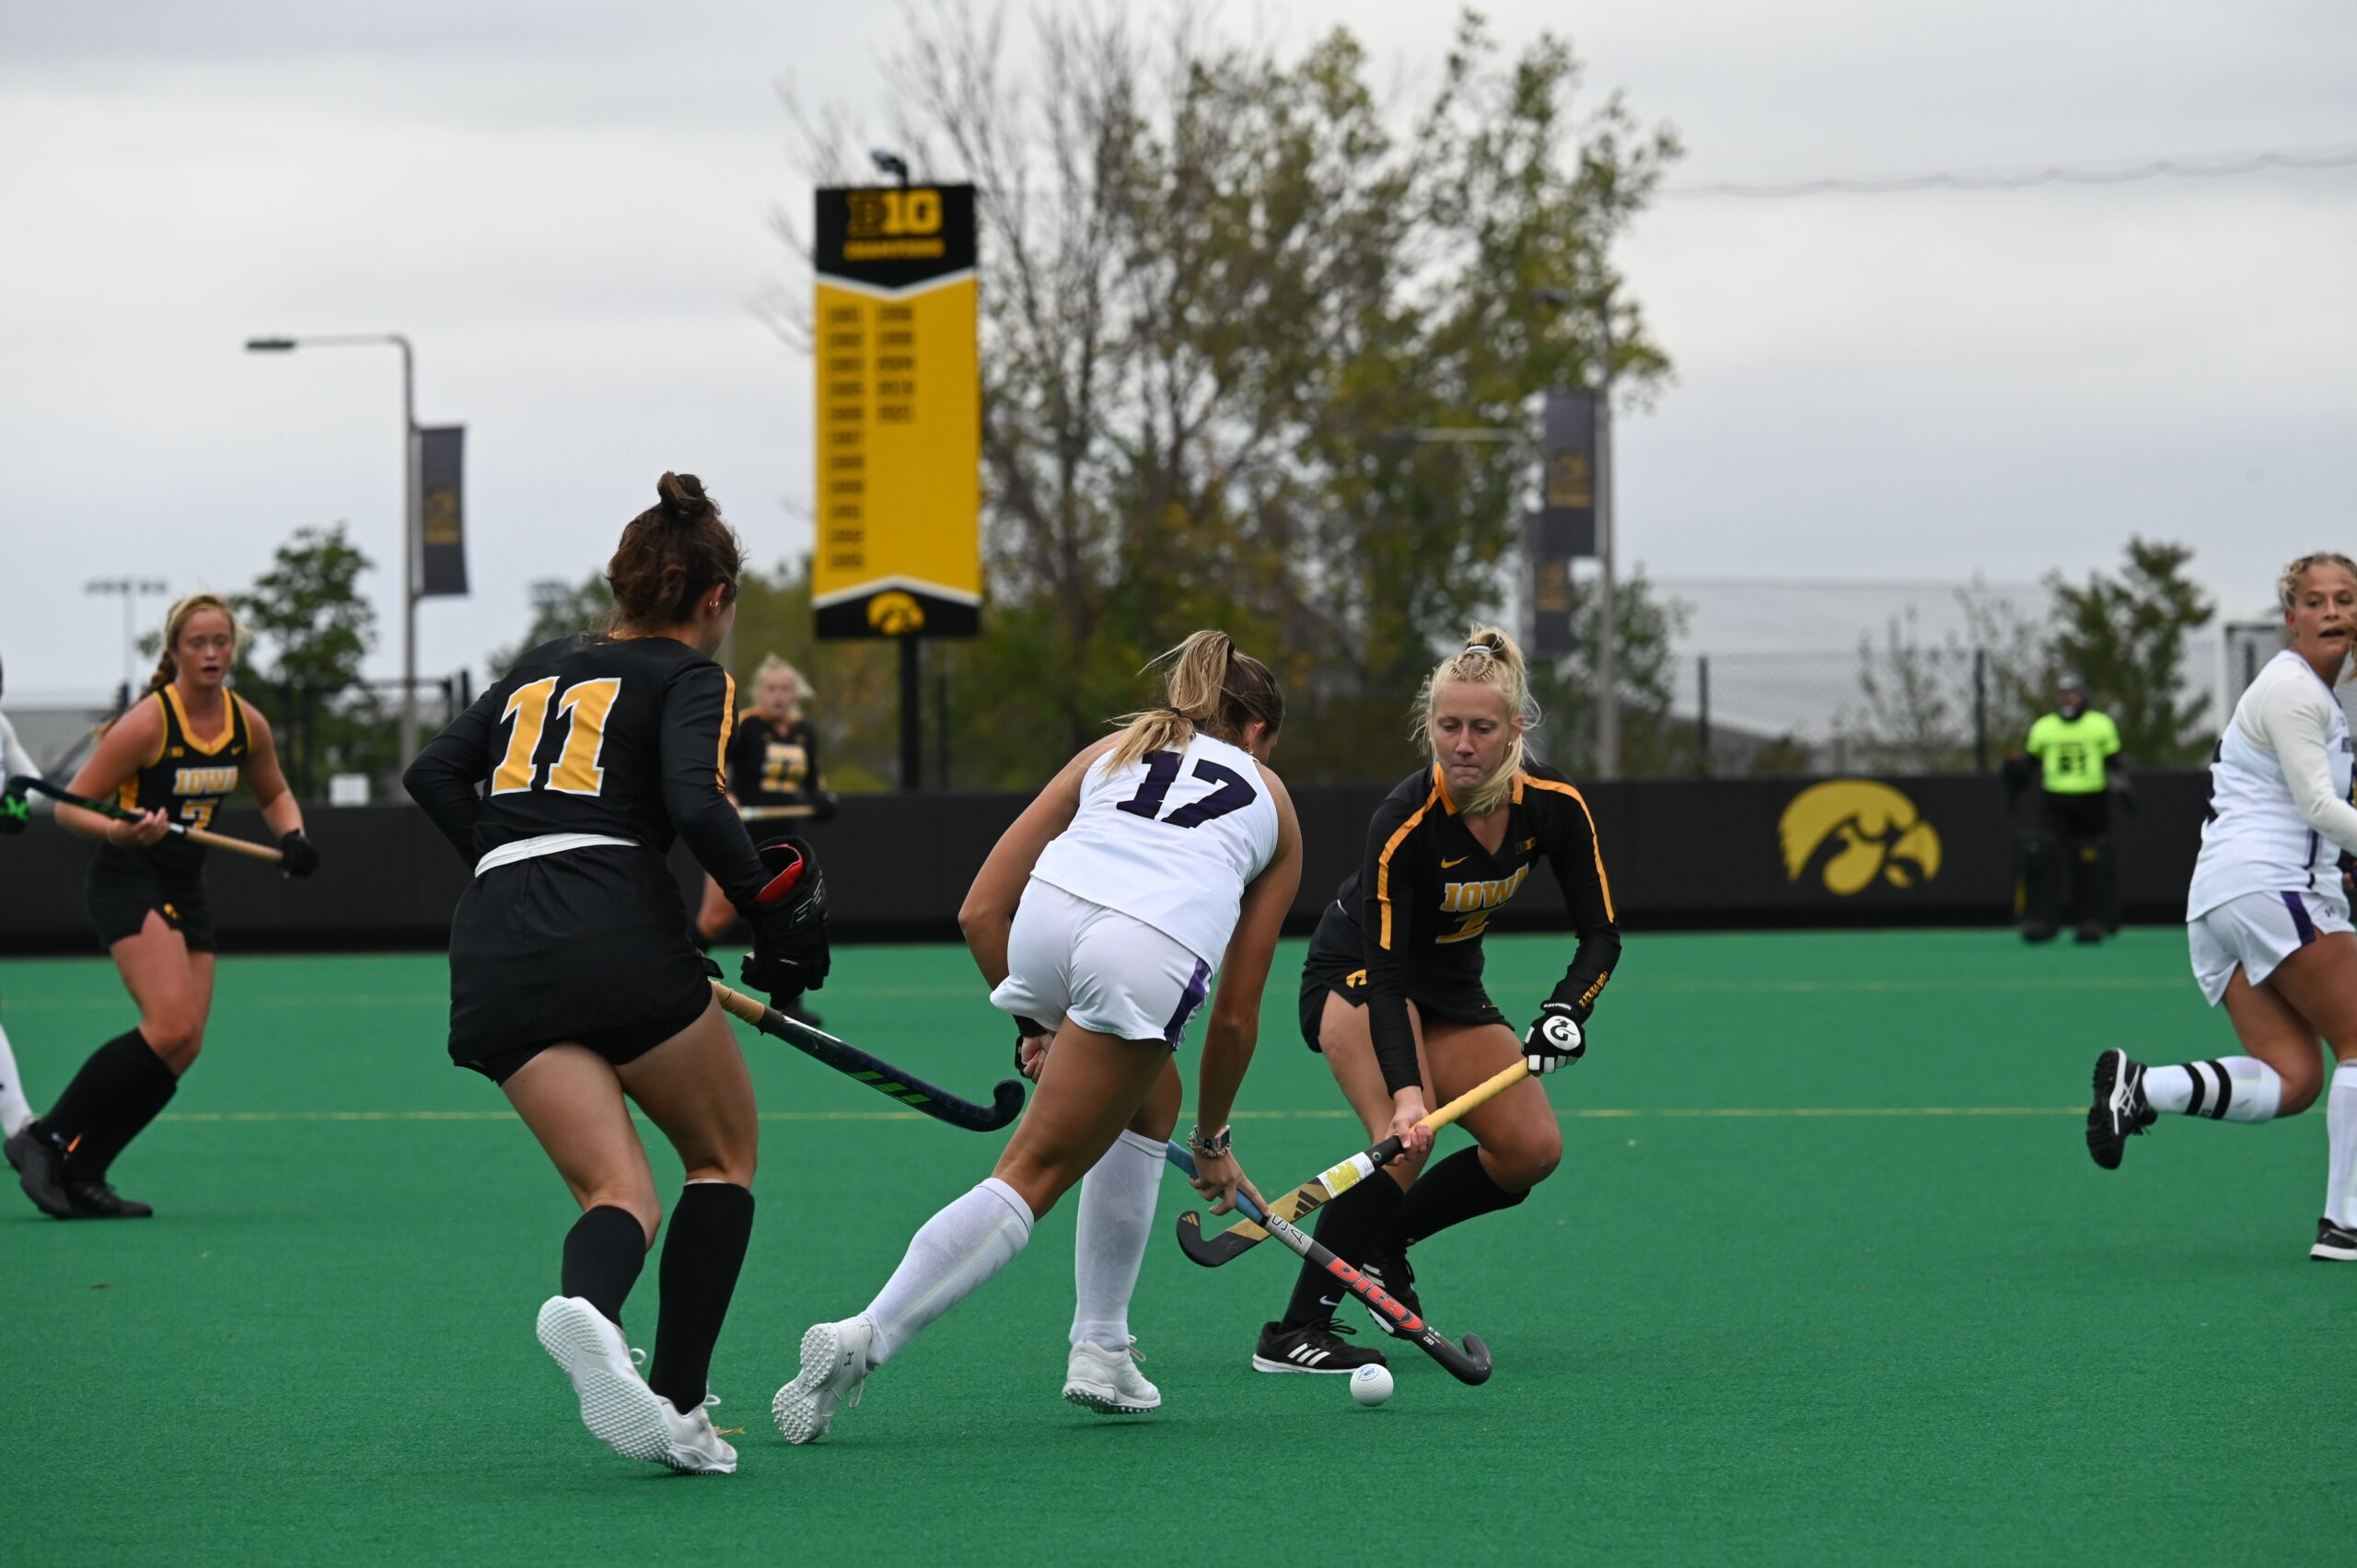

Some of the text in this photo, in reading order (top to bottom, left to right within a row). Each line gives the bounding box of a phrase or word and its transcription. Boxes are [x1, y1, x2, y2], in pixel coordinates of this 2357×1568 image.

[491, 676, 622, 797] 11
[1116, 750, 1258, 829] 17
[1326, 1257, 1412, 1324] Dita
